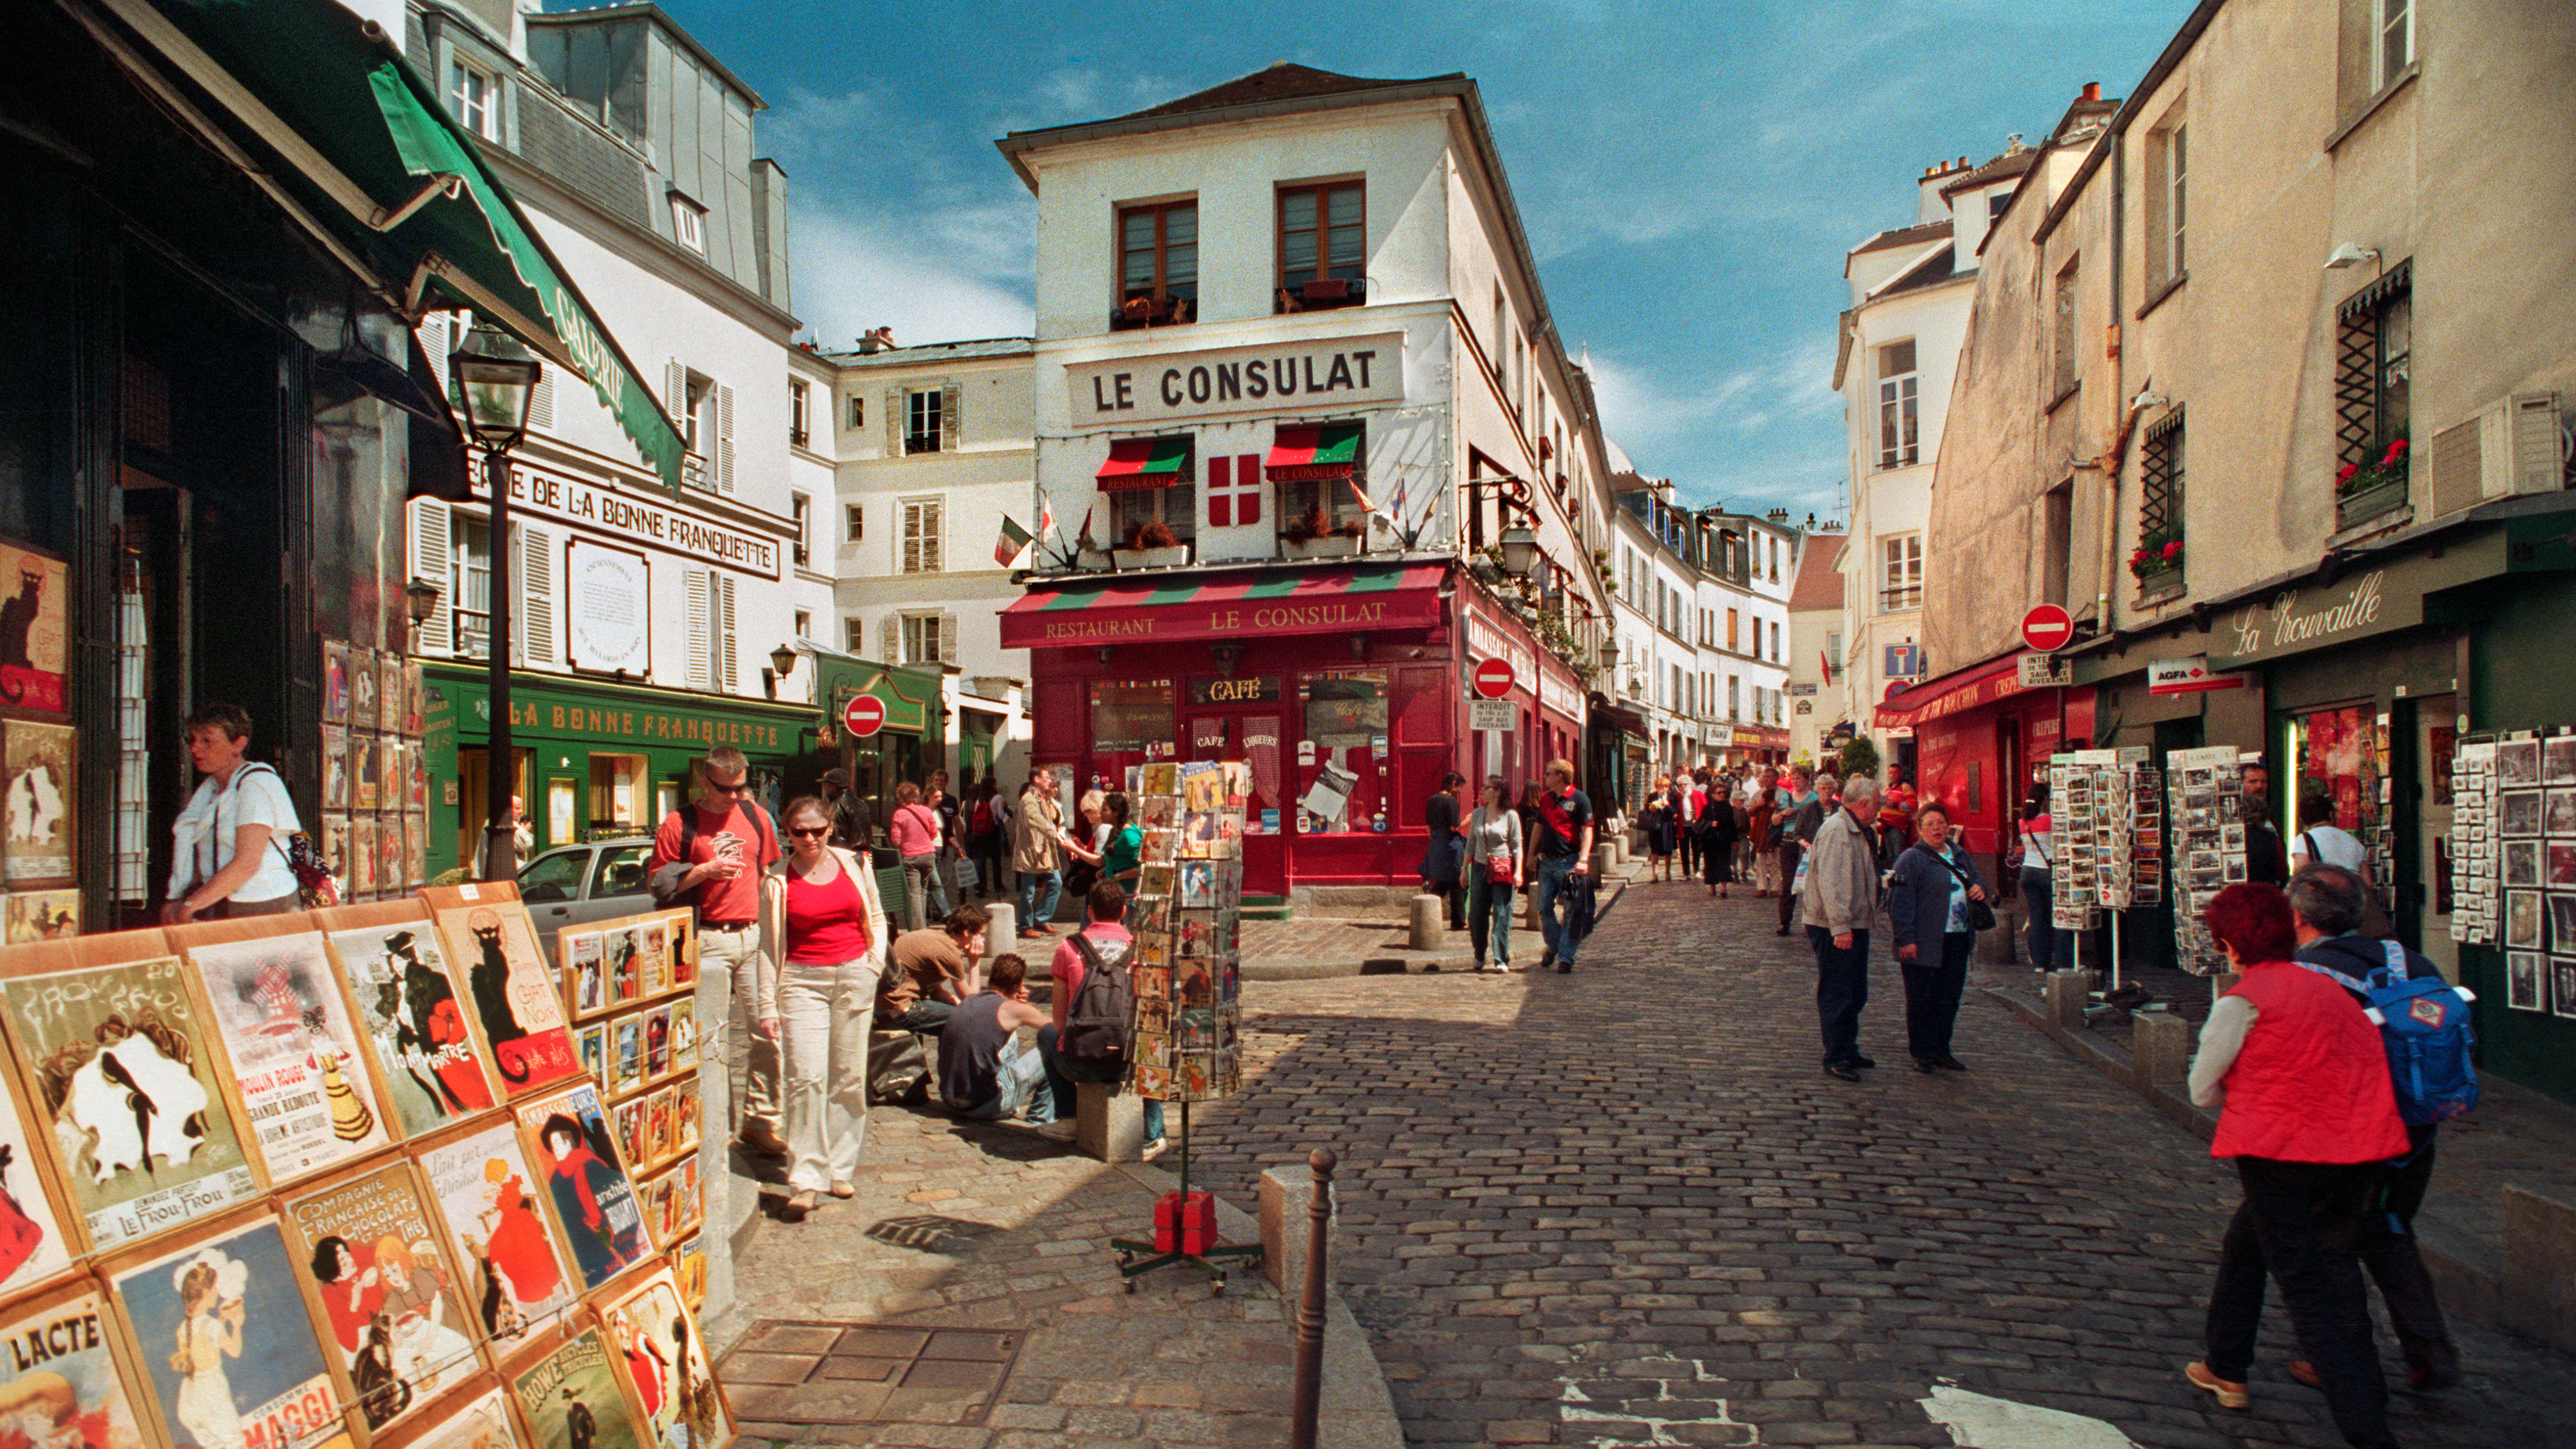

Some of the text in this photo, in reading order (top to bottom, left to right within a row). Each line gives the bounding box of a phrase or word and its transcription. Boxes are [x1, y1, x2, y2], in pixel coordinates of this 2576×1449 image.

[1094, 351, 1375, 411] LE CONSULAT
[1108, 476, 1167, 489] RESTAURANT
[1275, 466, 1345, 479] LE CONSULAT
[533, 476, 560, 509] DE
[568, 487, 594, 519] LA
[603, 497, 664, 538] BONNE
[671, 518, 771, 568] FRANQUETTE
[1211, 602, 1386, 630] LE CONSULAT
[2233, 570, 2383, 656] La Trouvaille
[1047, 619, 1154, 638] RESTAURANT
[2158, 671, 2188, 681] AGFA
[1210, 677, 1261, 700] CAFÉ
[510, 702, 777, 747] LA BONNE FRANQUETTE
[524, 1004, 561, 1024] NOIR
[237, 1073, 274, 1097] MOULIN
[275, 1065, 306, 1087] ROUGE
[301, 1158, 310, 1167] 3
[297, 1178, 385, 1223] COMPAGNIE
[388, 1187, 406, 1201] DES
[119, 1216, 139, 1237] LE
[339, 1196, 417, 1240] CHOCOLATS
[362, 1231, 372, 1243] ET
[376, 1222, 394, 1236] DES
[523, 1341, 598, 1413] HOWE BICYCLES
[561, 1353, 604, 1377] TRICYCLES
[242, 1386, 334, 1449] MAGGI
